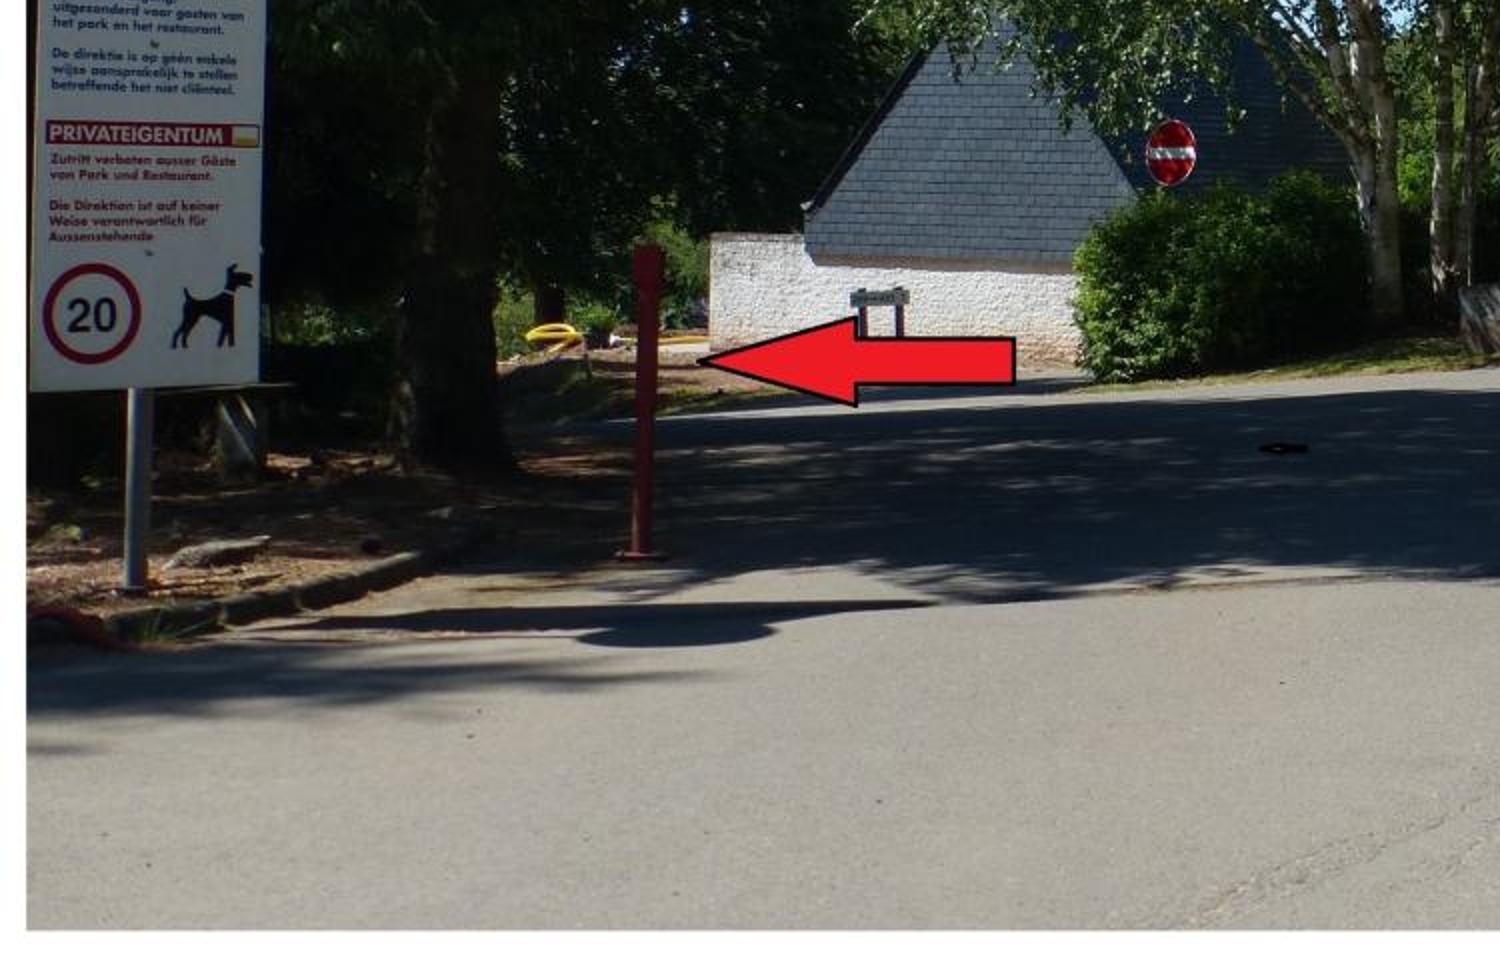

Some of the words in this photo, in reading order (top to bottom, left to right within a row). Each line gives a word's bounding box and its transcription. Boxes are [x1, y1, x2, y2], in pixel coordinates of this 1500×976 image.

[52, 2, 139, 17] uitgezonderd
[143, 7, 171, 17] voor
[176, 9, 217, 21] gasten
[221, 11, 245, 21] van
[52, 17, 73, 29] het
[77, 18, 108, 31] park
[113, 22, 129, 31] en
[133, 20, 152, 32] het
[157, 23, 224, 36] restaurant.
[52, 47, 69, 59] De
[74, 48, 123, 62] direktie
[127, 49, 139, 62] is
[141, 54, 157, 65] op
[196, 53, 237, 65] enkele
[52, 63, 86, 76] wijze
[91, 63, 179, 80] aansprakelijk
[183, 68, 194, 79] te
[198, 68, 238, 80] stellen
[51, 78, 127, 92] betreffende
[131, 80, 151, 92] het
[156, 81, 178, 93] niet
[50, 125, 224, 144] PRIVATEIGENTUM
[50, 153, 91, 165] Zutritt
[95, 154, 152, 166] verboten
[156, 156, 197, 167] ausser
[201, 154, 237, 167] Gäste
[50, 170, 75, 180] von
[79, 168, 109, 180] Park
[113, 169, 138, 180] und
[50, 200, 69, 211] Die
[74, 200, 132, 212] Direktion
[138, 200, 153, 211] ist
[156, 200, 177, 212] auf
[181, 200, 220, 212] keiner
[50, 214, 87, 226] Weise
[91, 215, 185, 227] verantwortlich
[188, 214, 208, 227] für
[67, 297, 117, 333] 20
